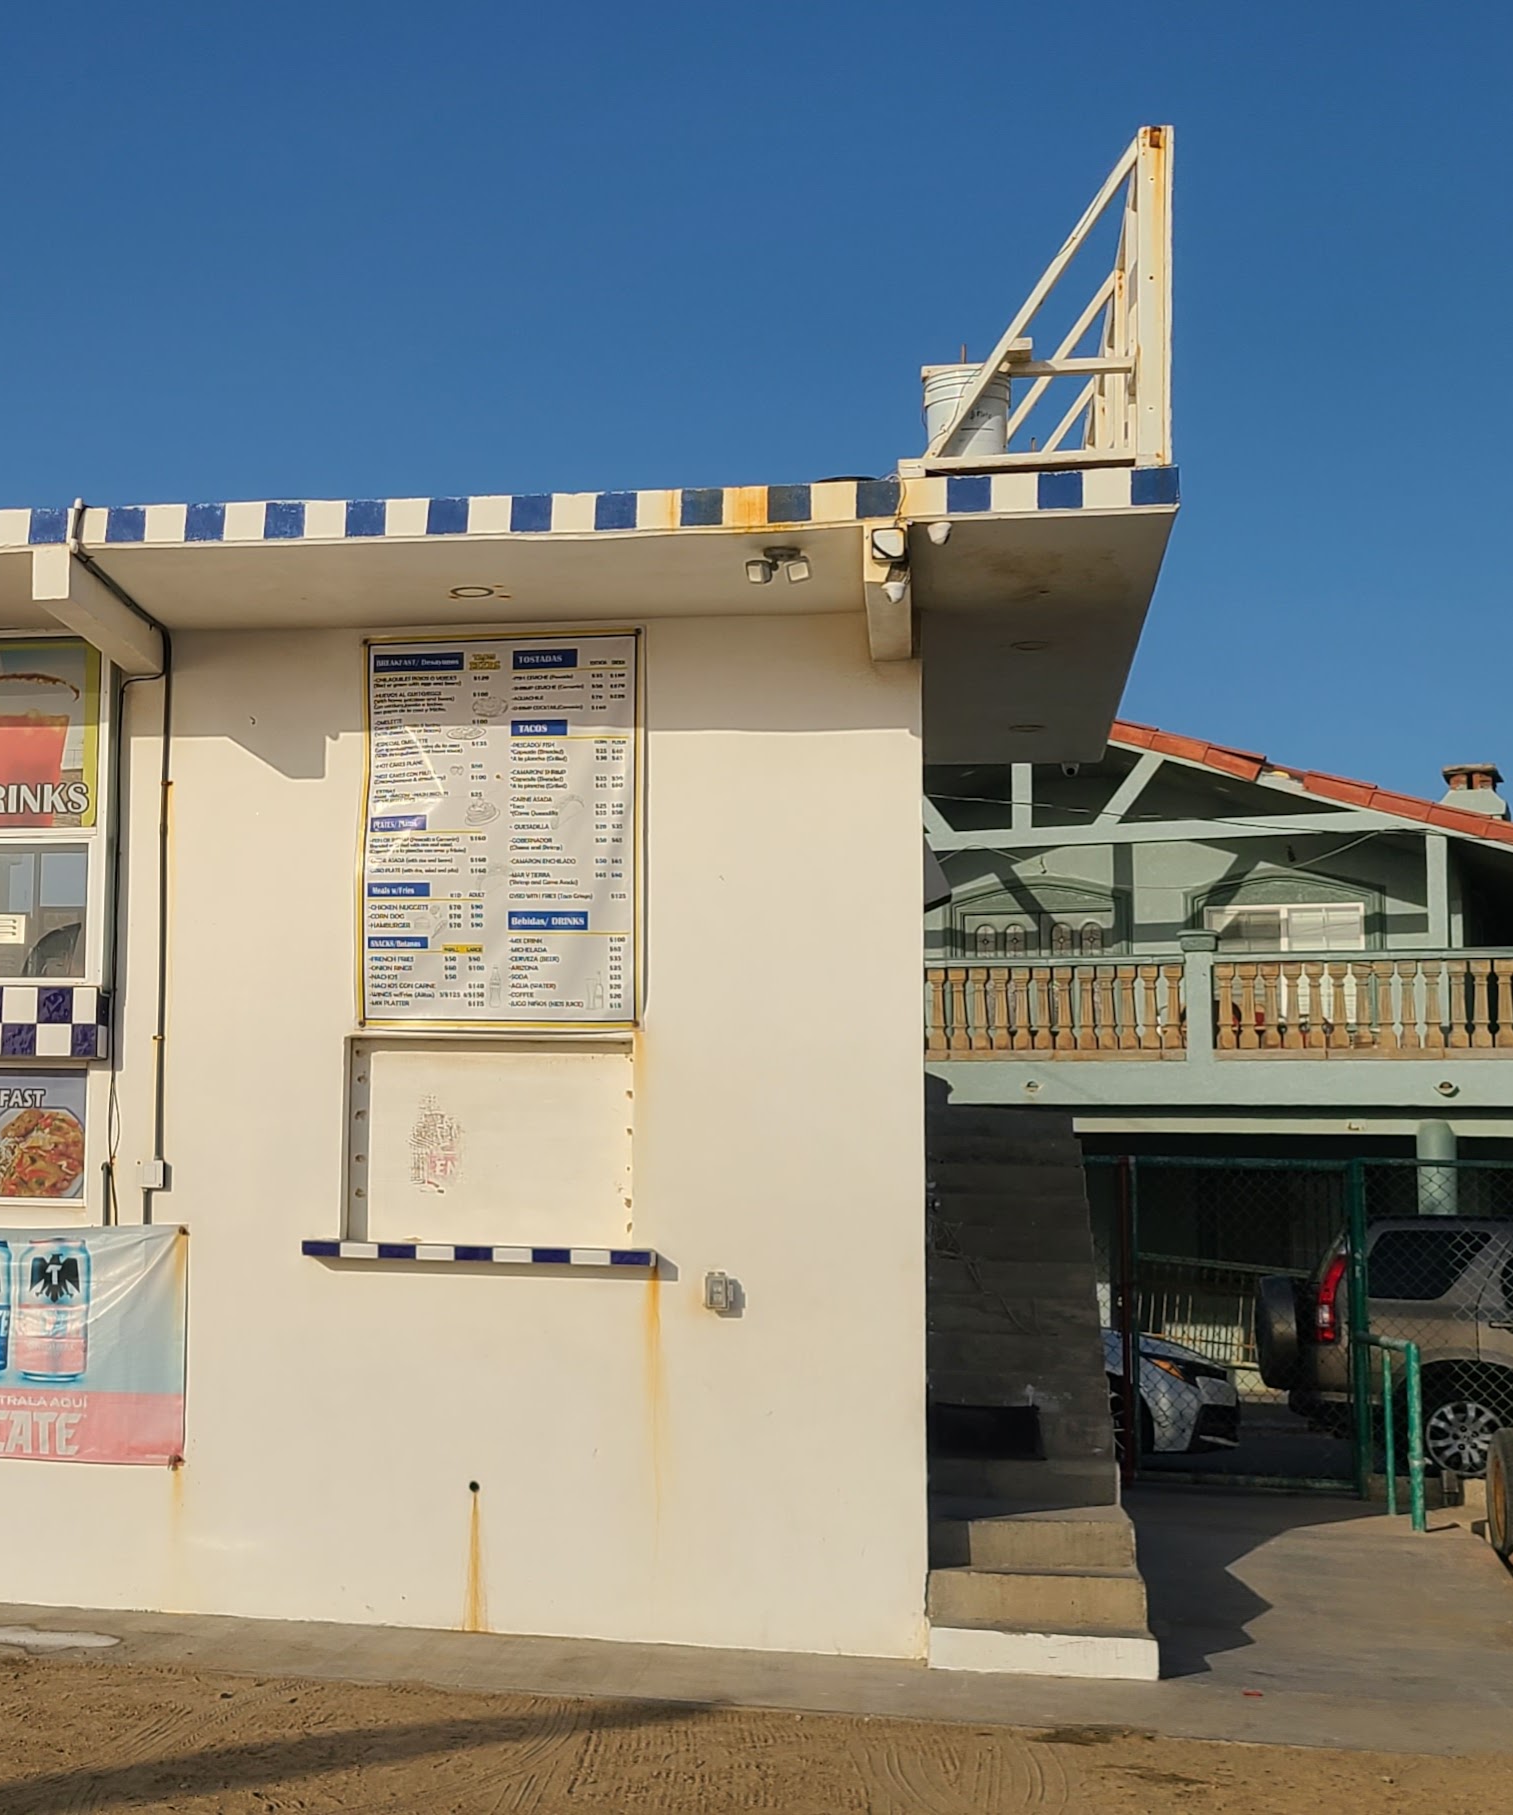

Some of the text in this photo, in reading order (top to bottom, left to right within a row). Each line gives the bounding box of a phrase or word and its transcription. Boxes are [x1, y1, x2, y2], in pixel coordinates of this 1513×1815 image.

[518, 655, 562, 664] TOSTADAS
[519, 725, 547, 733] TACOS
[511, 917, 585, 926] Bebidas/ DRINKS
[46, 1264, 62, 1284] T
[50, 1395, 88, 1408] AQUÍ
